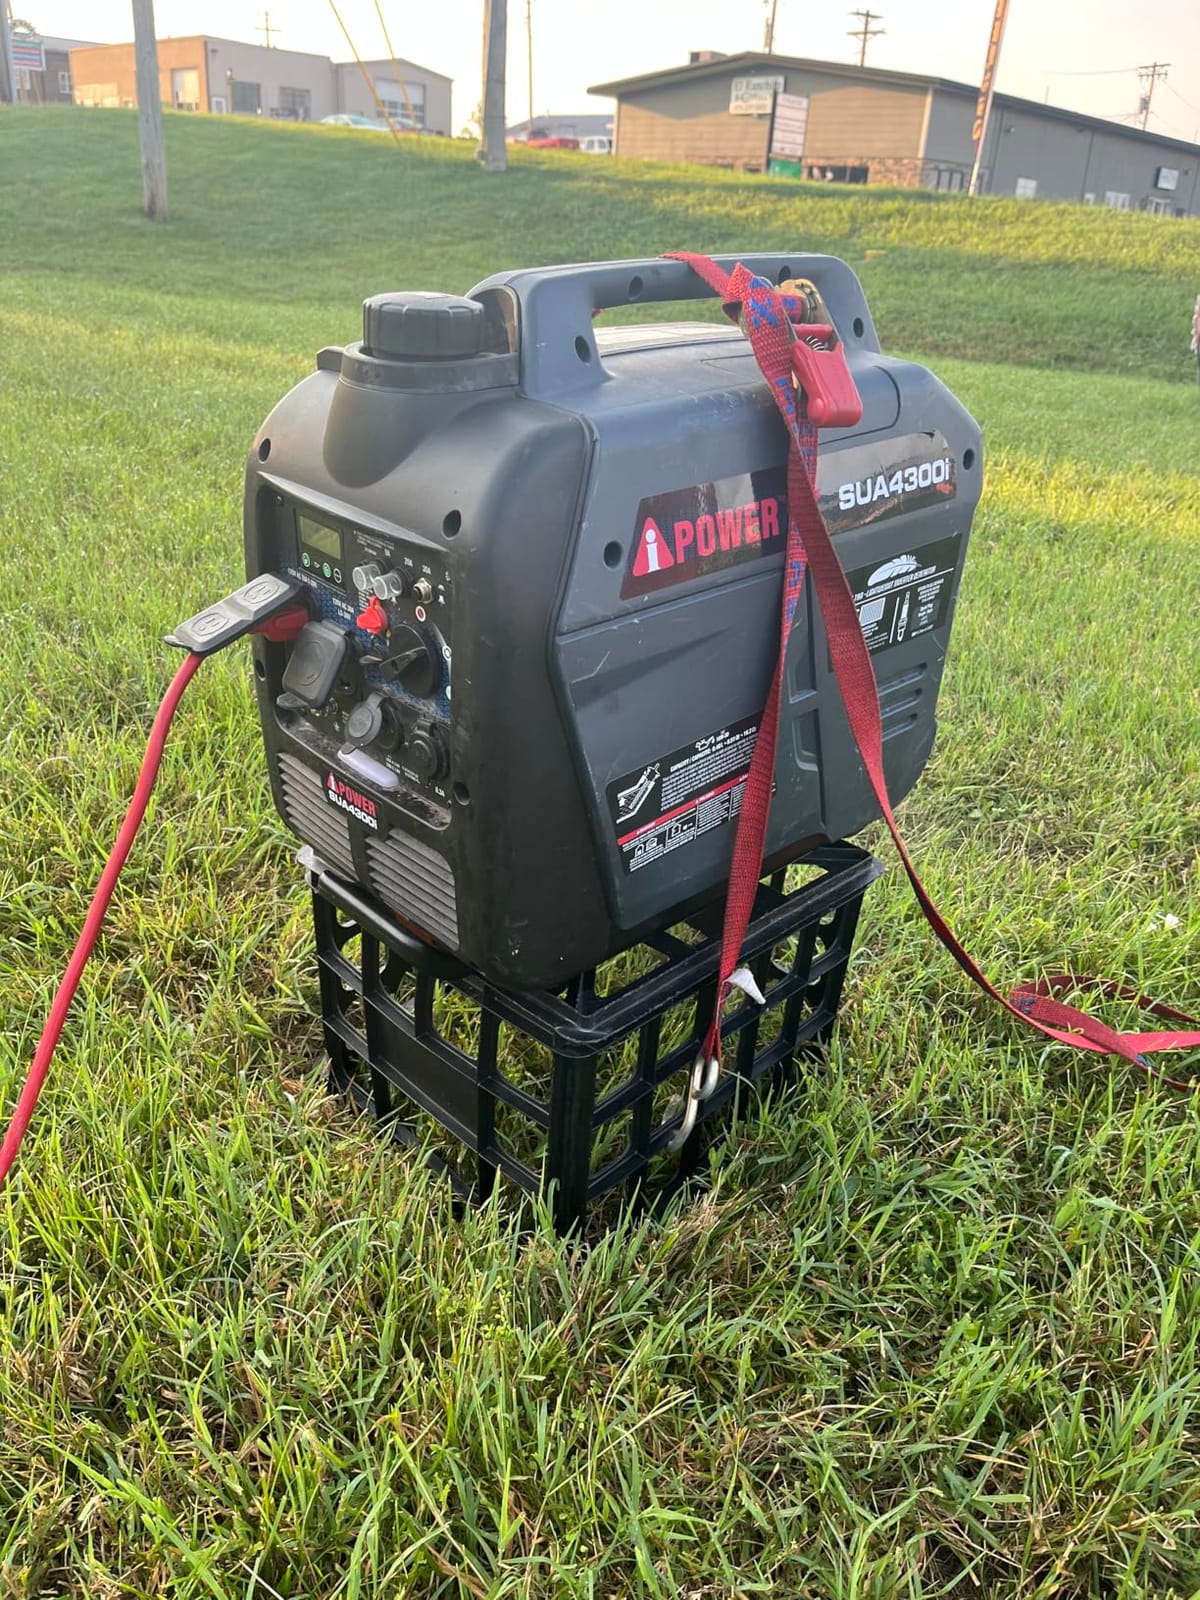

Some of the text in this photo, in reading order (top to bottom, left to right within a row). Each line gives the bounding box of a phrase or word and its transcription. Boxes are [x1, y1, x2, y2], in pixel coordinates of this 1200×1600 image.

[838, 457, 950, 511] SUA4300i
[673, 498, 780, 564] POWER
[328, 789, 378, 830] SUA4300i
[338, 781, 377, 818] POWER
